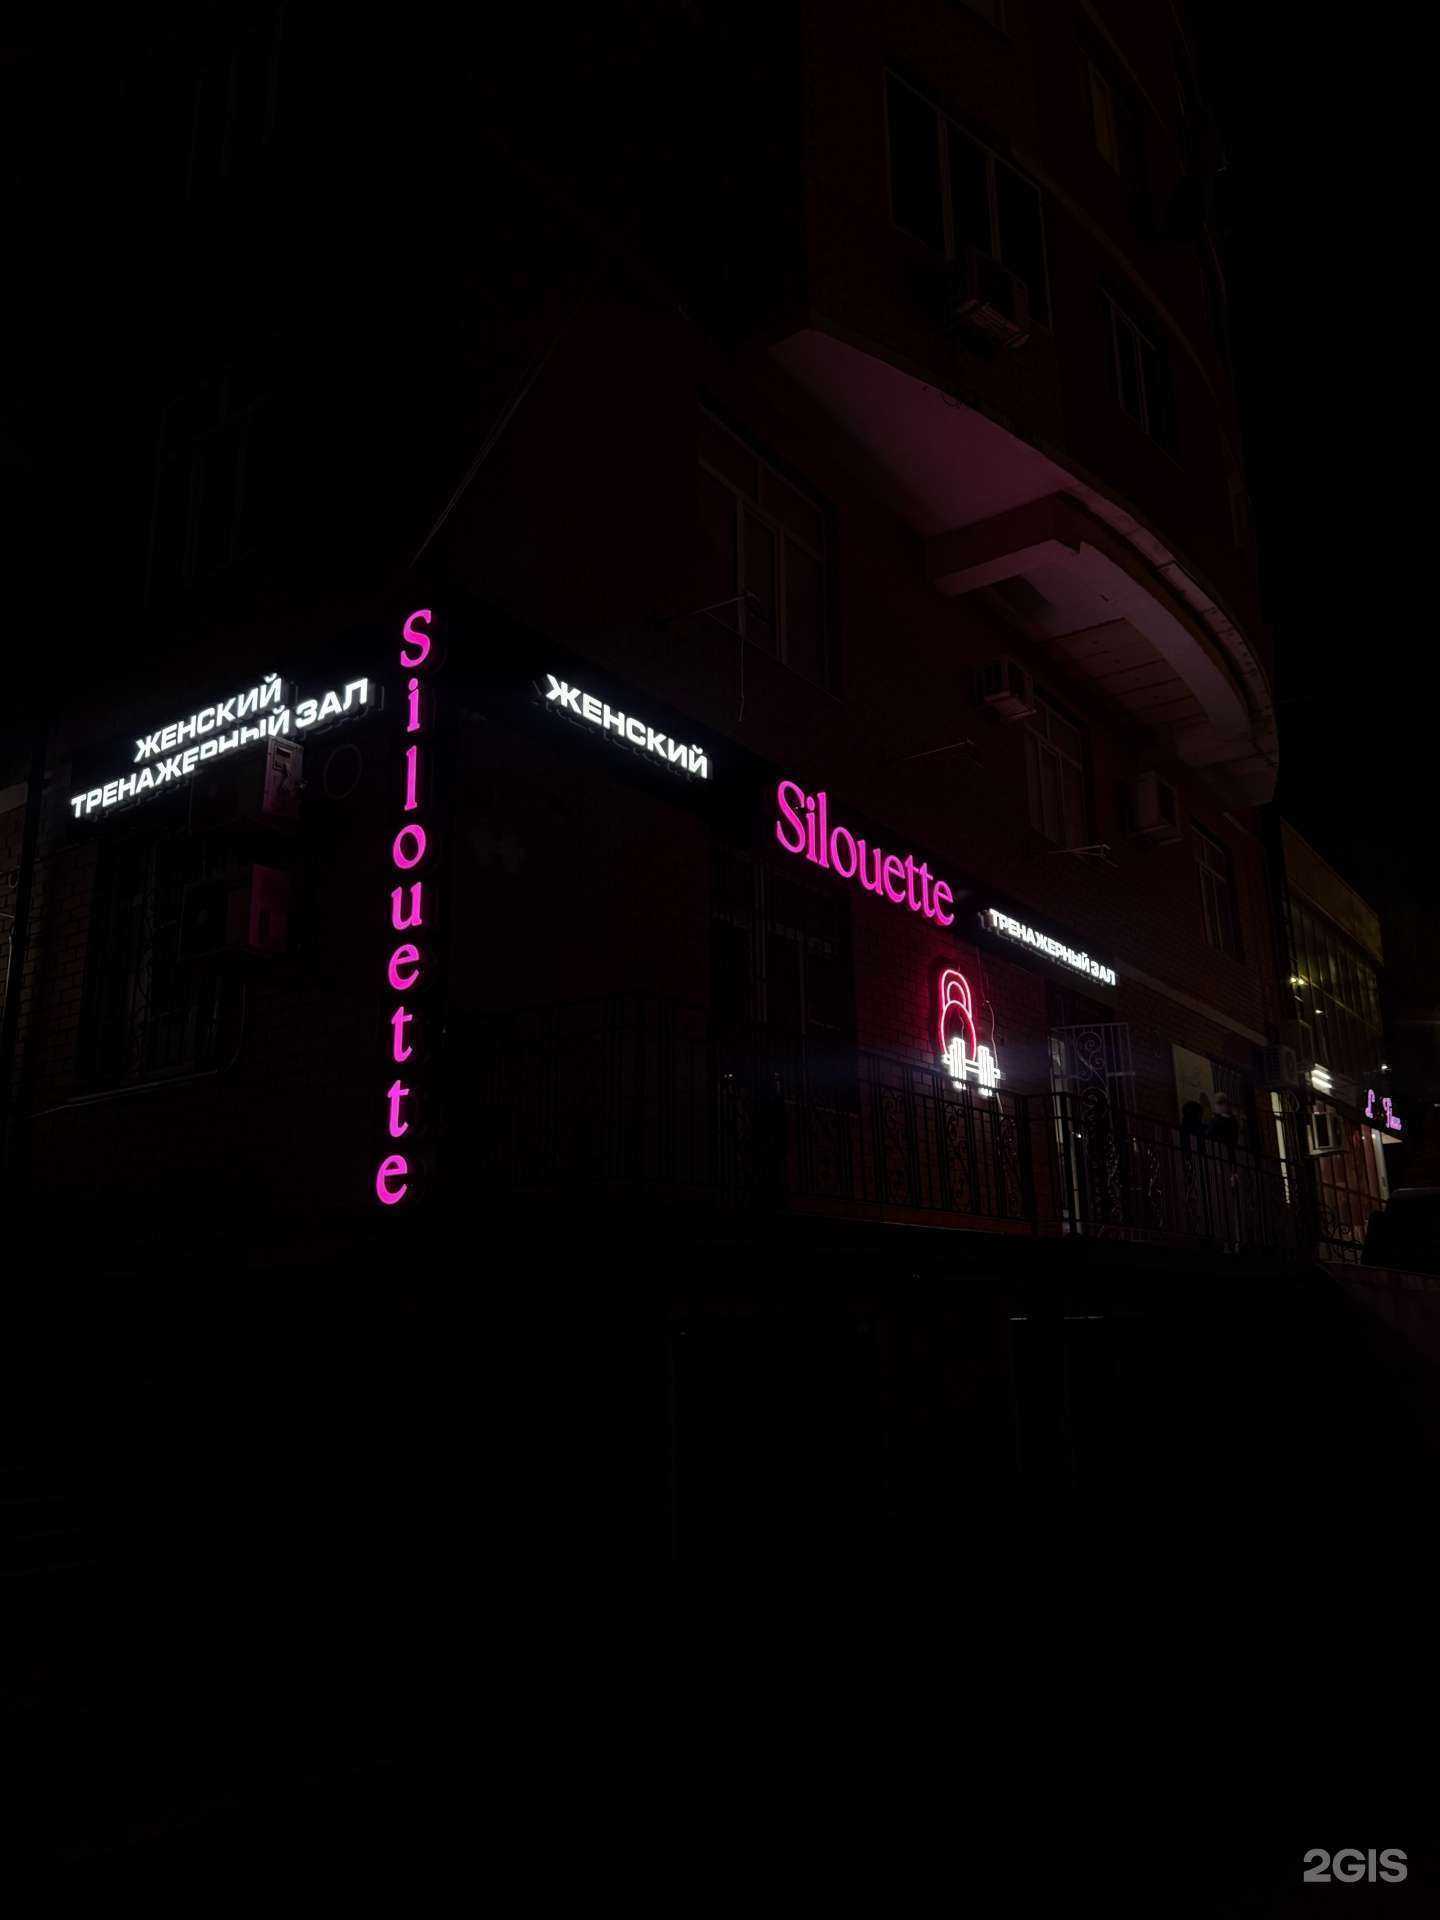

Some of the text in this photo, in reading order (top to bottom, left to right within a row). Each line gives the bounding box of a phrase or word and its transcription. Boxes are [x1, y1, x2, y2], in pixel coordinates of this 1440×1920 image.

[133, 672, 283, 764] ЖЕНСКИЙ
[294, 677, 369, 730] ЗАЛ
[545, 673, 710, 780] ЖЕНСКИЙ
[775, 780, 955, 927] Silouette
[375, 608, 433, 1206] Silouette
[988, 907, 1117, 986] ТРЕНАЖЕРНЫЙ ЗАЛ
